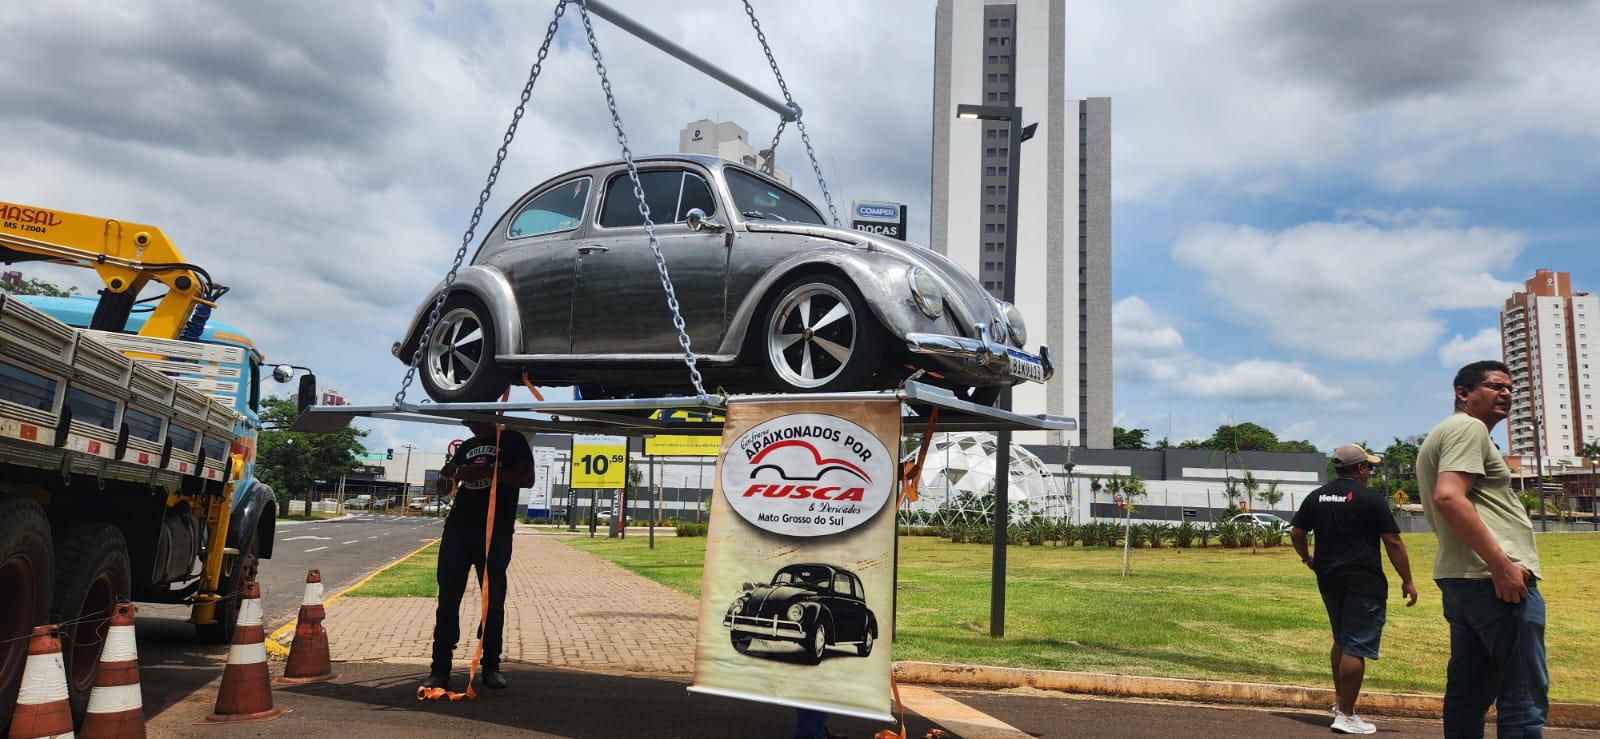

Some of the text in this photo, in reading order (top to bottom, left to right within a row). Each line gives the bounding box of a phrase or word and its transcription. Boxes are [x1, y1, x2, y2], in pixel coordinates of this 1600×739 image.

[859, 207, 894, 216] COMPER
[4, 221, 46, 233] MS 12004
[857, 225, 897, 235] DOCAS
[745, 426, 872, 462] APAIXONADOS POR
[742, 484, 865, 502] FUSCA
[808, 502, 816, 511] &
[758, 512, 844, 526] Mato Grosso do Sul
